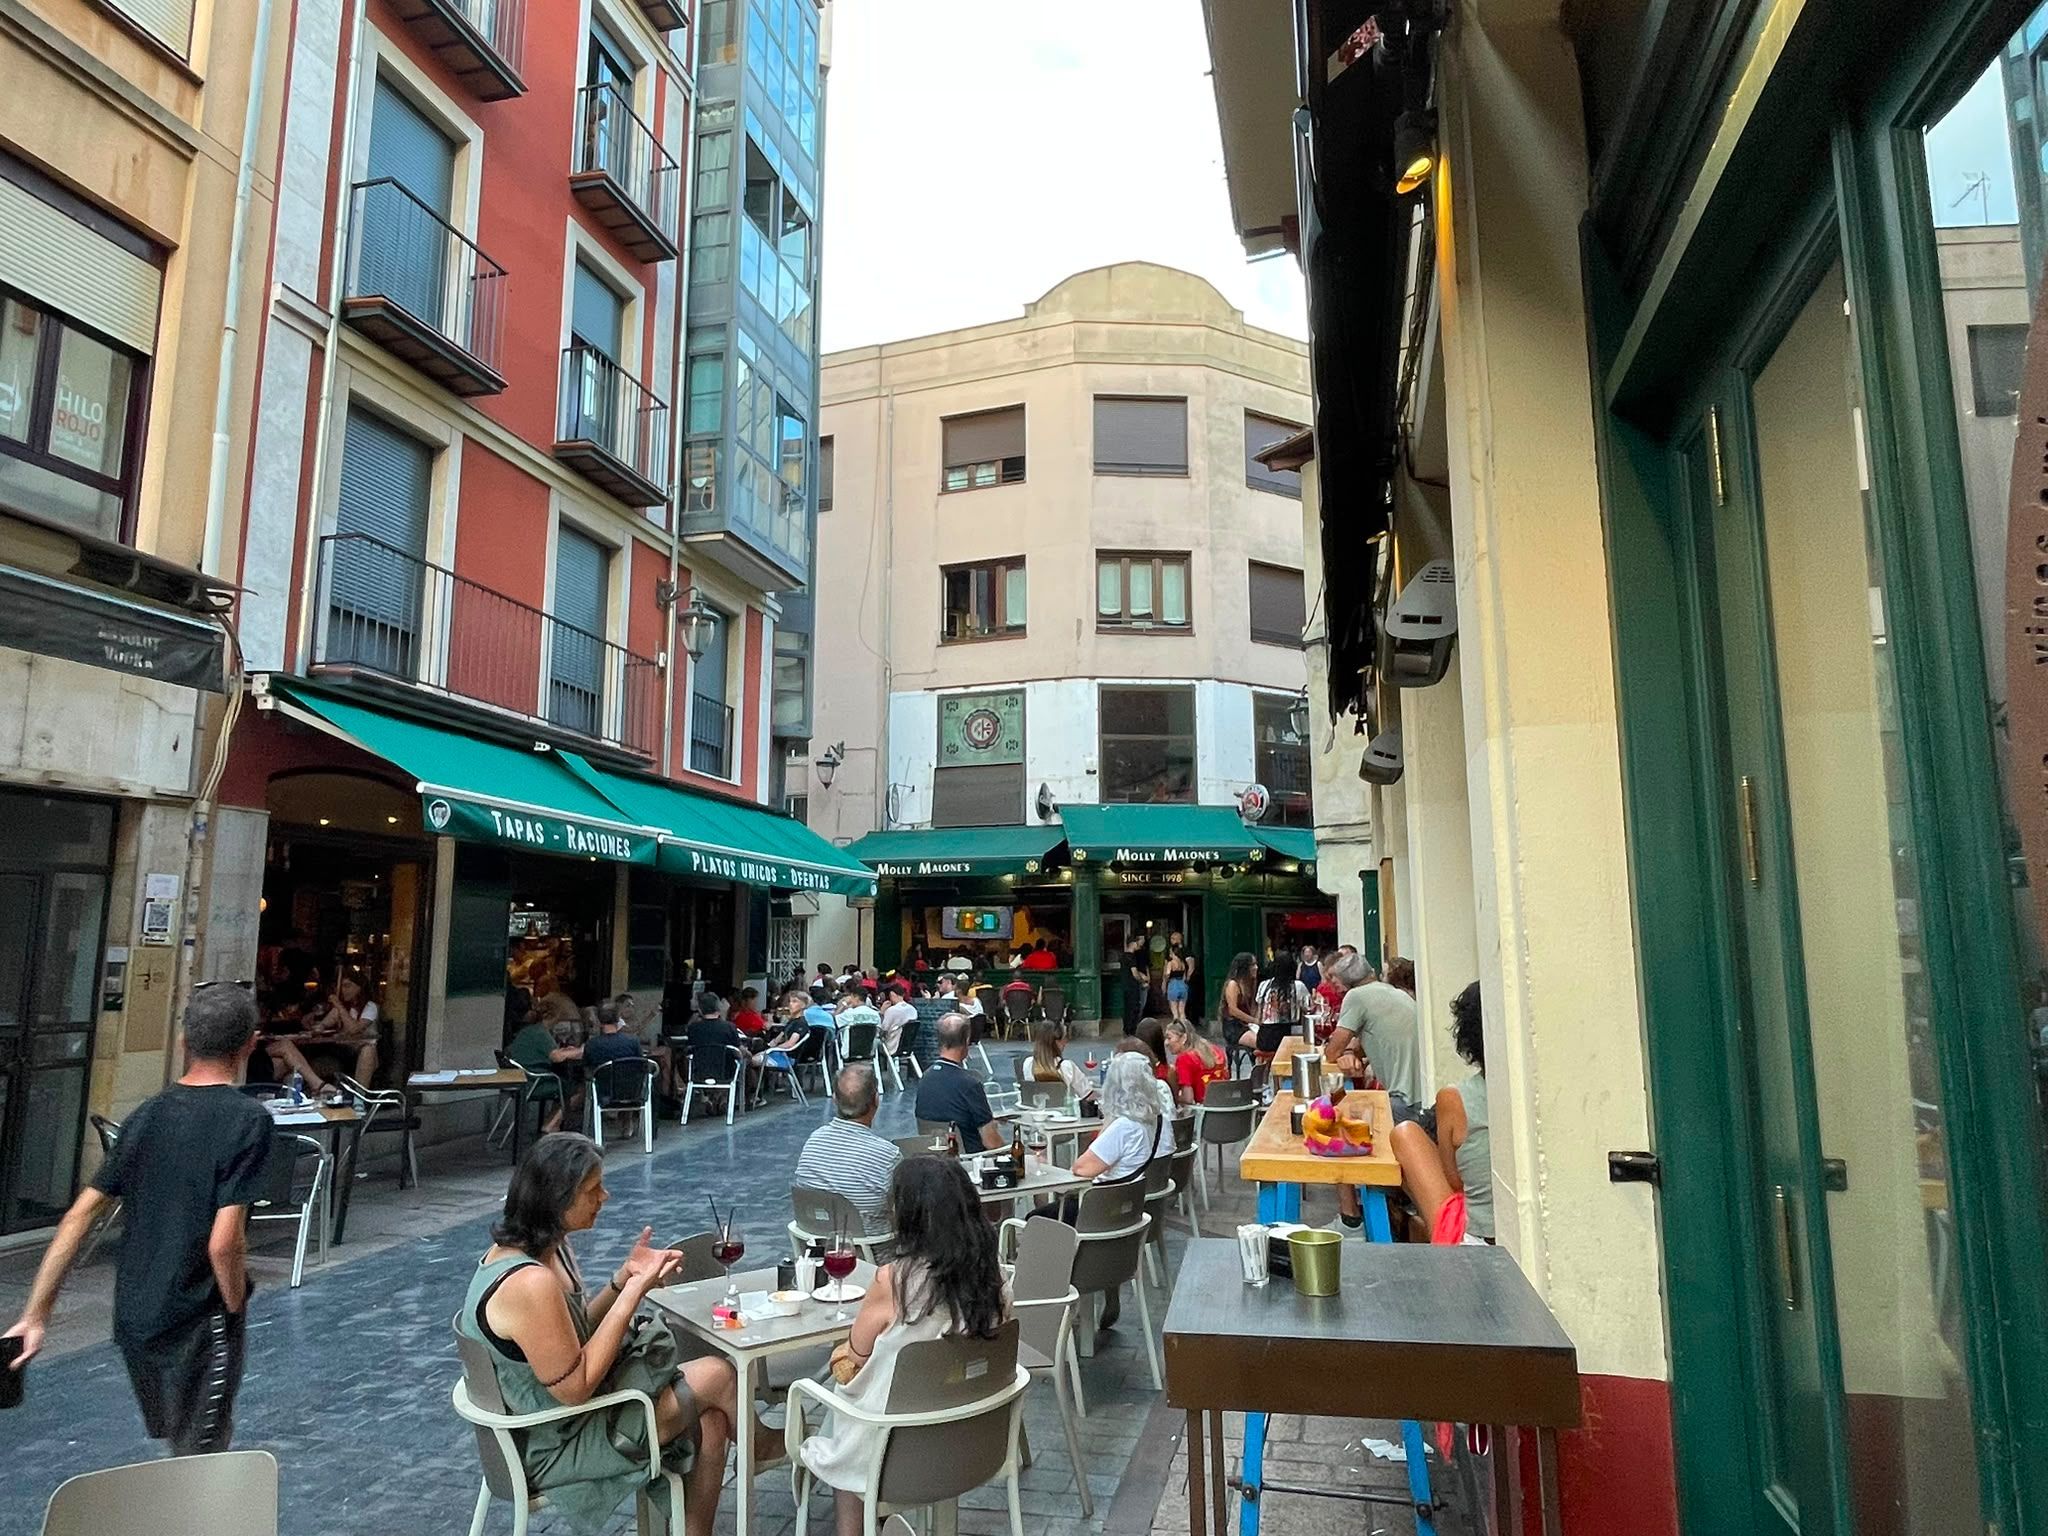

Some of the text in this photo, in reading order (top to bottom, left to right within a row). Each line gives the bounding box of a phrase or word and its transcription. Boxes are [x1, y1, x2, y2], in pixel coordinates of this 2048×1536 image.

[59, 387, 104, 423] HILO
[56, 409, 101, 442] ROJO
[490, 810, 545, 845] TAPAS
[566, 824, 631, 858] RACIONES
[691, 851, 736, 877] PLATOS
[740, 862, 778, 883] UNICOS
[791, 868, 831, 890] OFERTAS
[877, 862, 971, 875] MOLLY MALONE'S
[1116, 848, 1220, 862] MOLLY MALONE'S
[1121, 873, 1151, 883] SINCE
[1162, 873, 1183, 883] 1998
